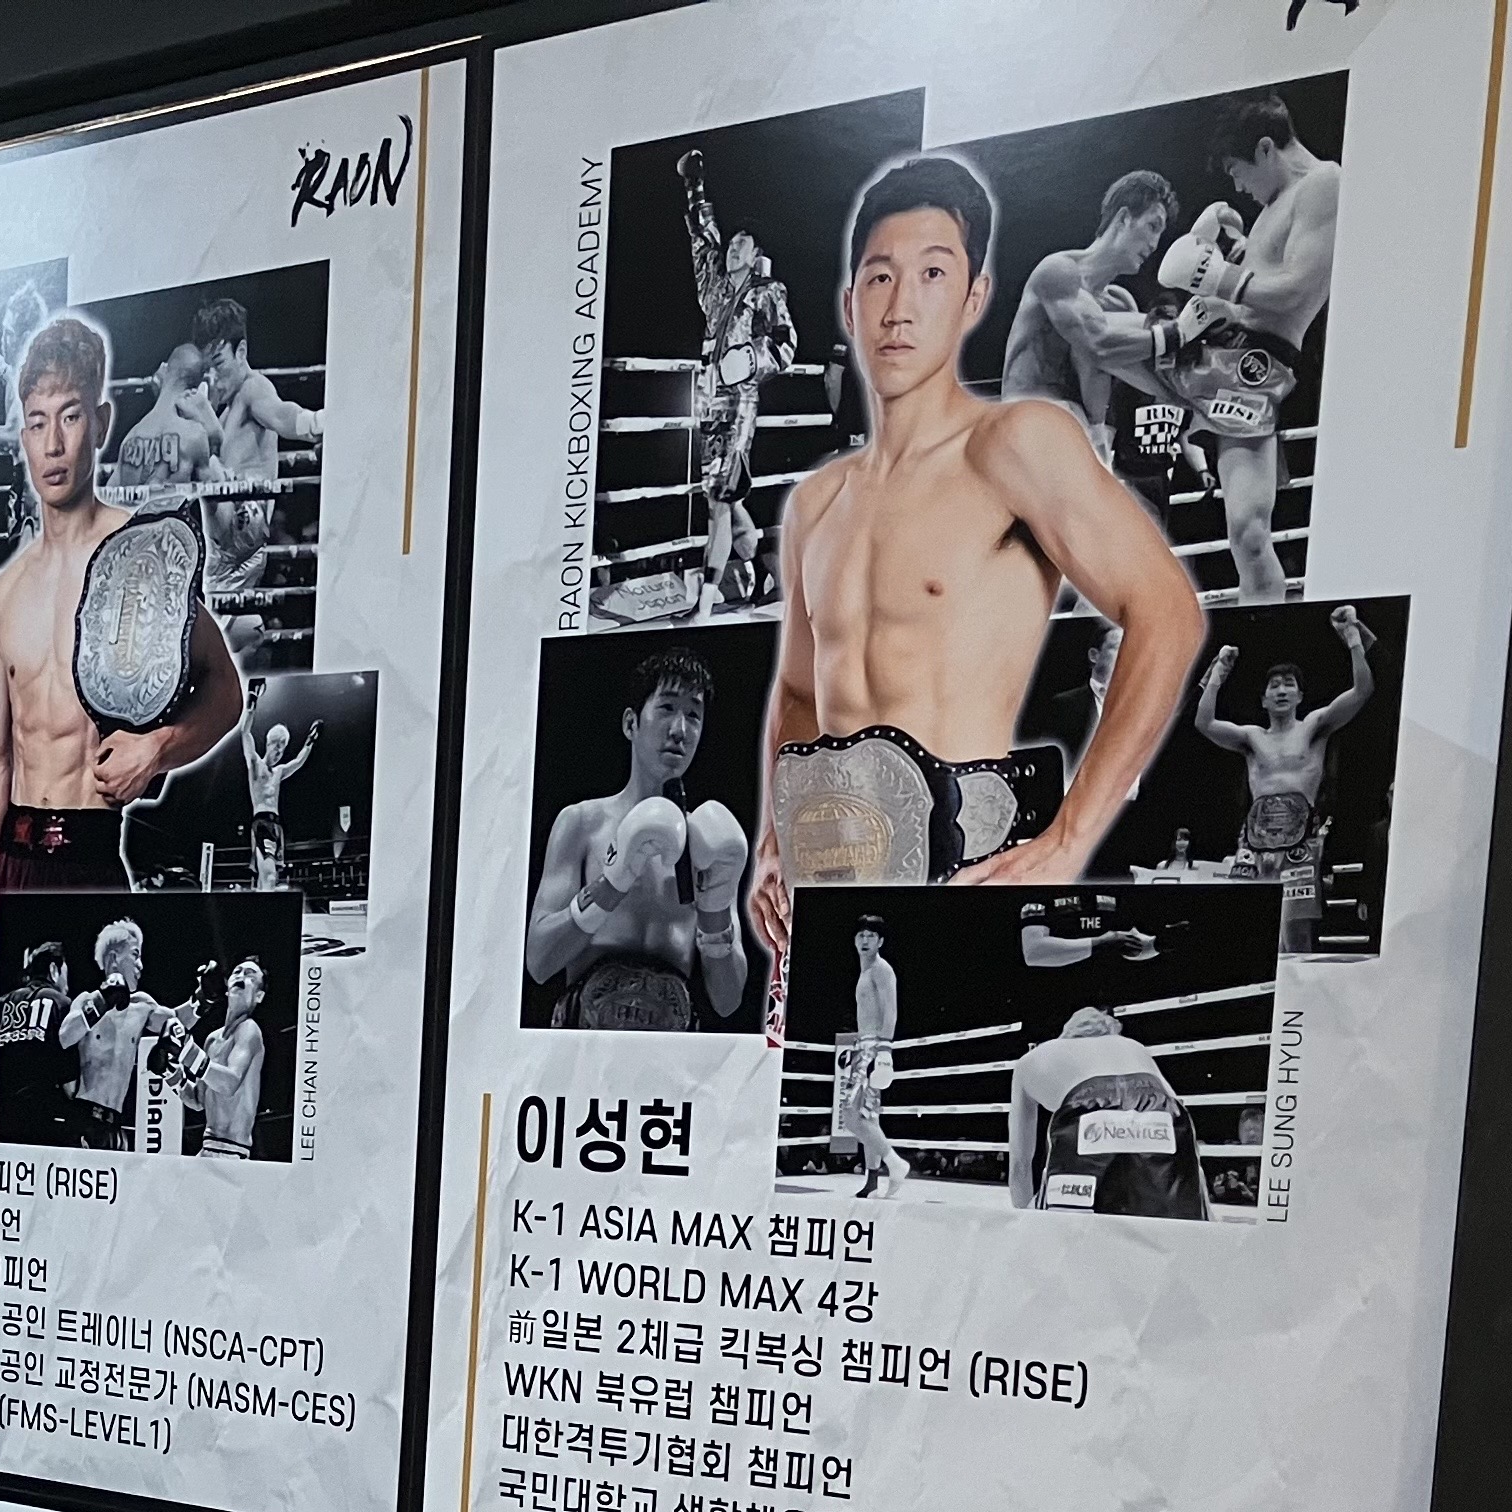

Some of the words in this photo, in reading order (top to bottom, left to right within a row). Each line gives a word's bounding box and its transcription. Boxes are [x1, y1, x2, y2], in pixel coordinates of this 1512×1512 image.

[290, 114, 413, 226] RAON
[575, 158, 603, 319] ACADEMY
[565, 333, 595, 528] KICKBOXING
[559, 543, 584, 630] RAON
[305, 967, 321, 1052] HYEONG
[1278, 1012, 1303, 1083] HYUN
[303, 1061, 317, 1118] CHAN
[301, 1126, 315, 1160] LEE
[518, 1096, 692, 1176] 이성현
[1271, 1095, 1297, 1167] SUNG
[47, 1163, 117, 1204] (RISE)
[1267, 1179, 1290, 1222] LEE
[514, 1199, 563, 1235] K-1
[580, 1205, 657, 1243] ASIA
[672, 1211, 753, 1250] MAX
[769, 1214, 874, 1263] 챔피언
[511, 1254, 560, 1291] K-1
[578, 1260, 705, 1303] WORLD
[720, 1272, 804, 1314] MAX
[818, 1281, 878, 1323] 4강
[2, 1303, 45, 1339] 공인
[57, 1310, 151, 1353] 트레이너
[164, 1320, 323, 1376] (NSCA-CPT)
[617, 1318, 703, 1364] 2체급
[720, 1328, 822, 1377] 킥복싱
[842, 1339, 950, 1391] 챔피언
[970, 1351, 1087, 1408] (RISE)
[0, 1395, 173, 1454] (FMS-LEVEL1)
[1, 1349, 43, 1386] 공인
[55, 1357, 177, 1405] 교정전문가
[188, 1372, 355, 1431] (NASM-CES)
[504, 1362, 581, 1403] WKN
[596, 1371, 692, 1420] 북유럽
[710, 1383, 811, 1435] 챔피언
[502, 1414, 730, 1480] 대한격투기협회
[749, 1446, 851, 1499] 챔피언
